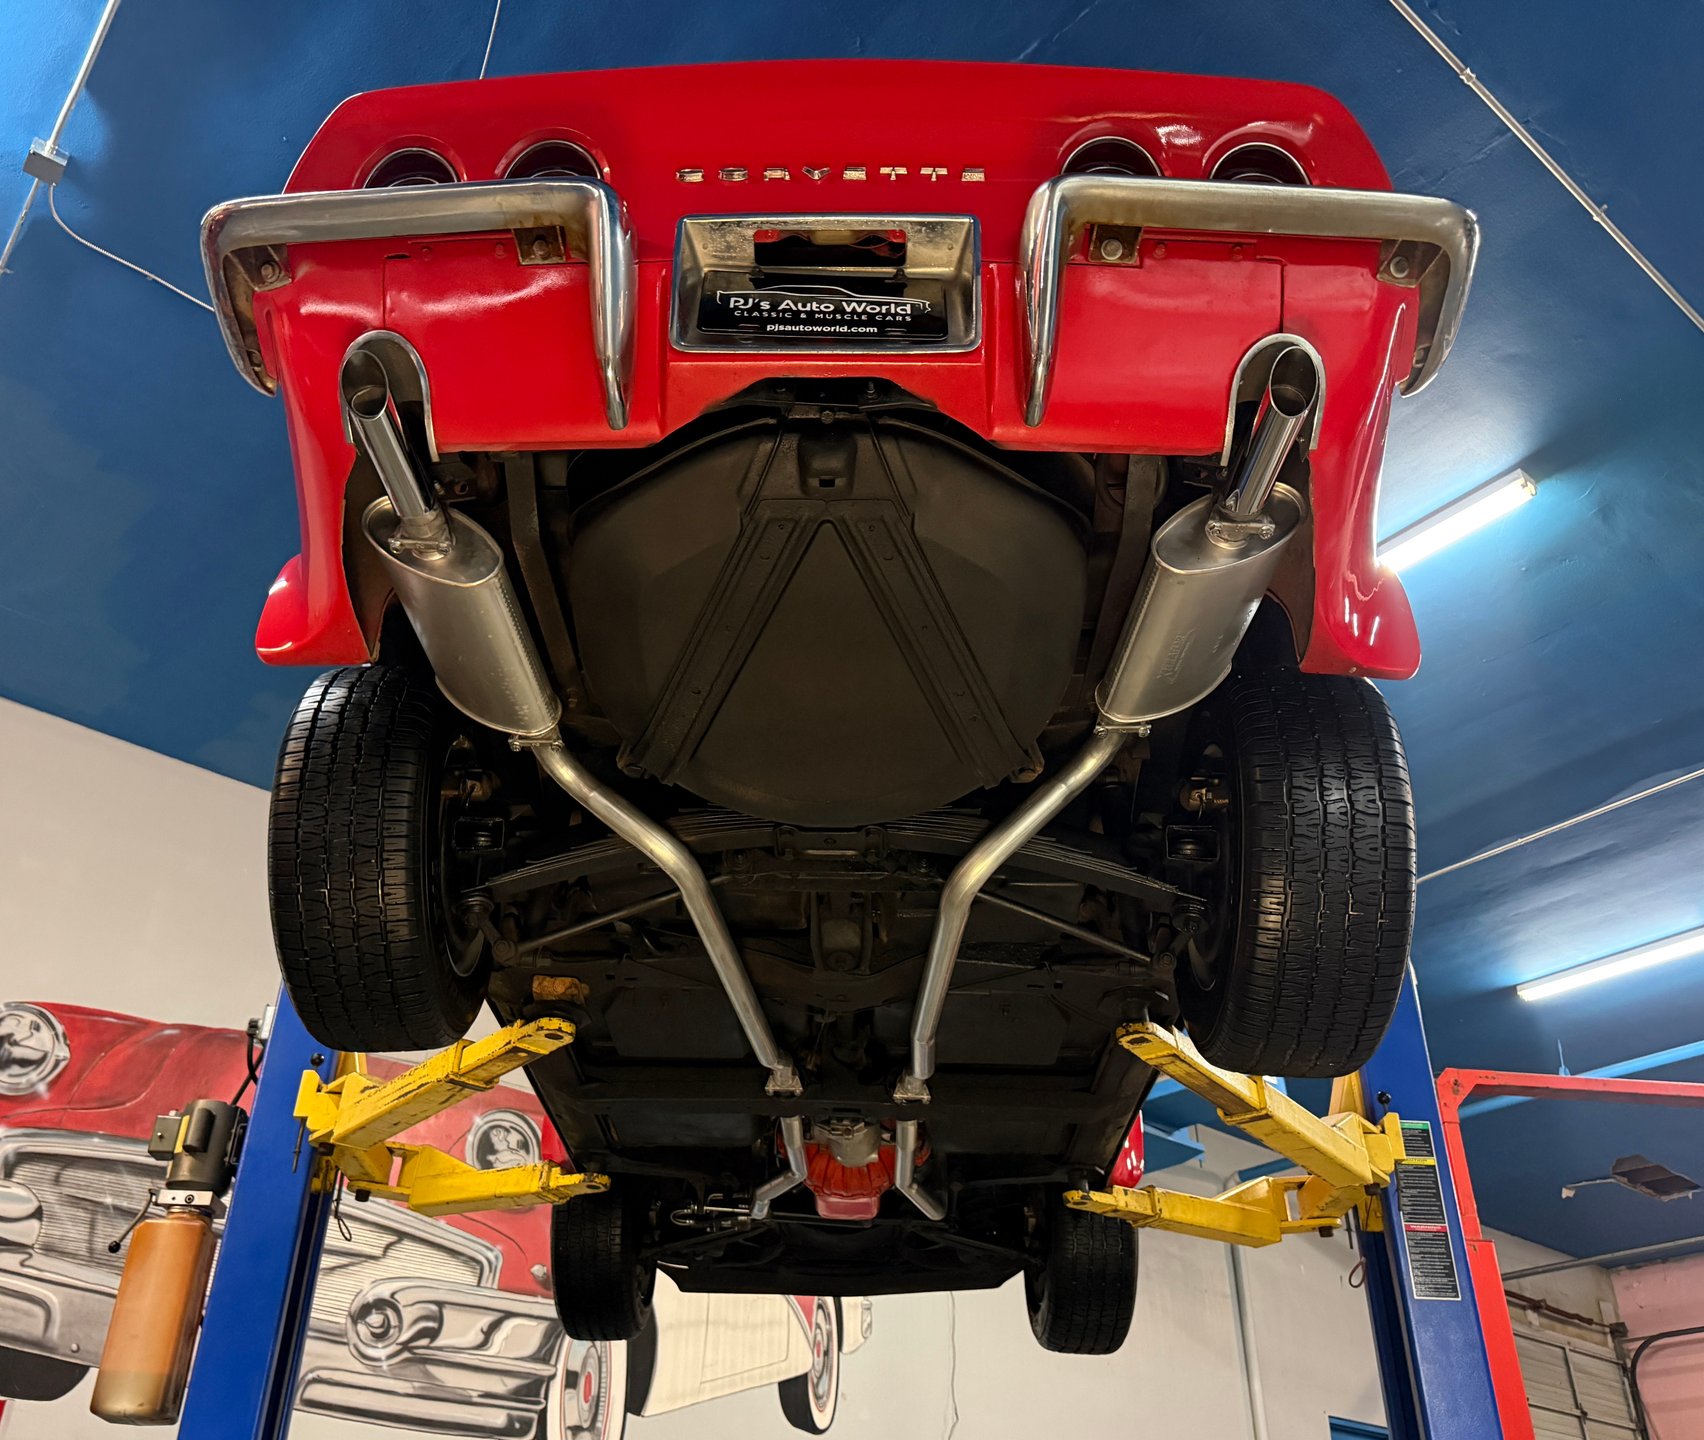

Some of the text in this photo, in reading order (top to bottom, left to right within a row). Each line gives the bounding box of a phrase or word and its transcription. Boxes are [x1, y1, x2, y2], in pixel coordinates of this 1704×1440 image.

[675, 166, 986, 183] CORVETTE
[729, 297, 912, 314] PJ's Auto World
[734, 310, 793, 318] CLASSIC
[815, 313, 868, 321] MUSCLE
[875, 314, 912, 322] CARS
[766, 323, 878, 334] pjsautoworld.com
